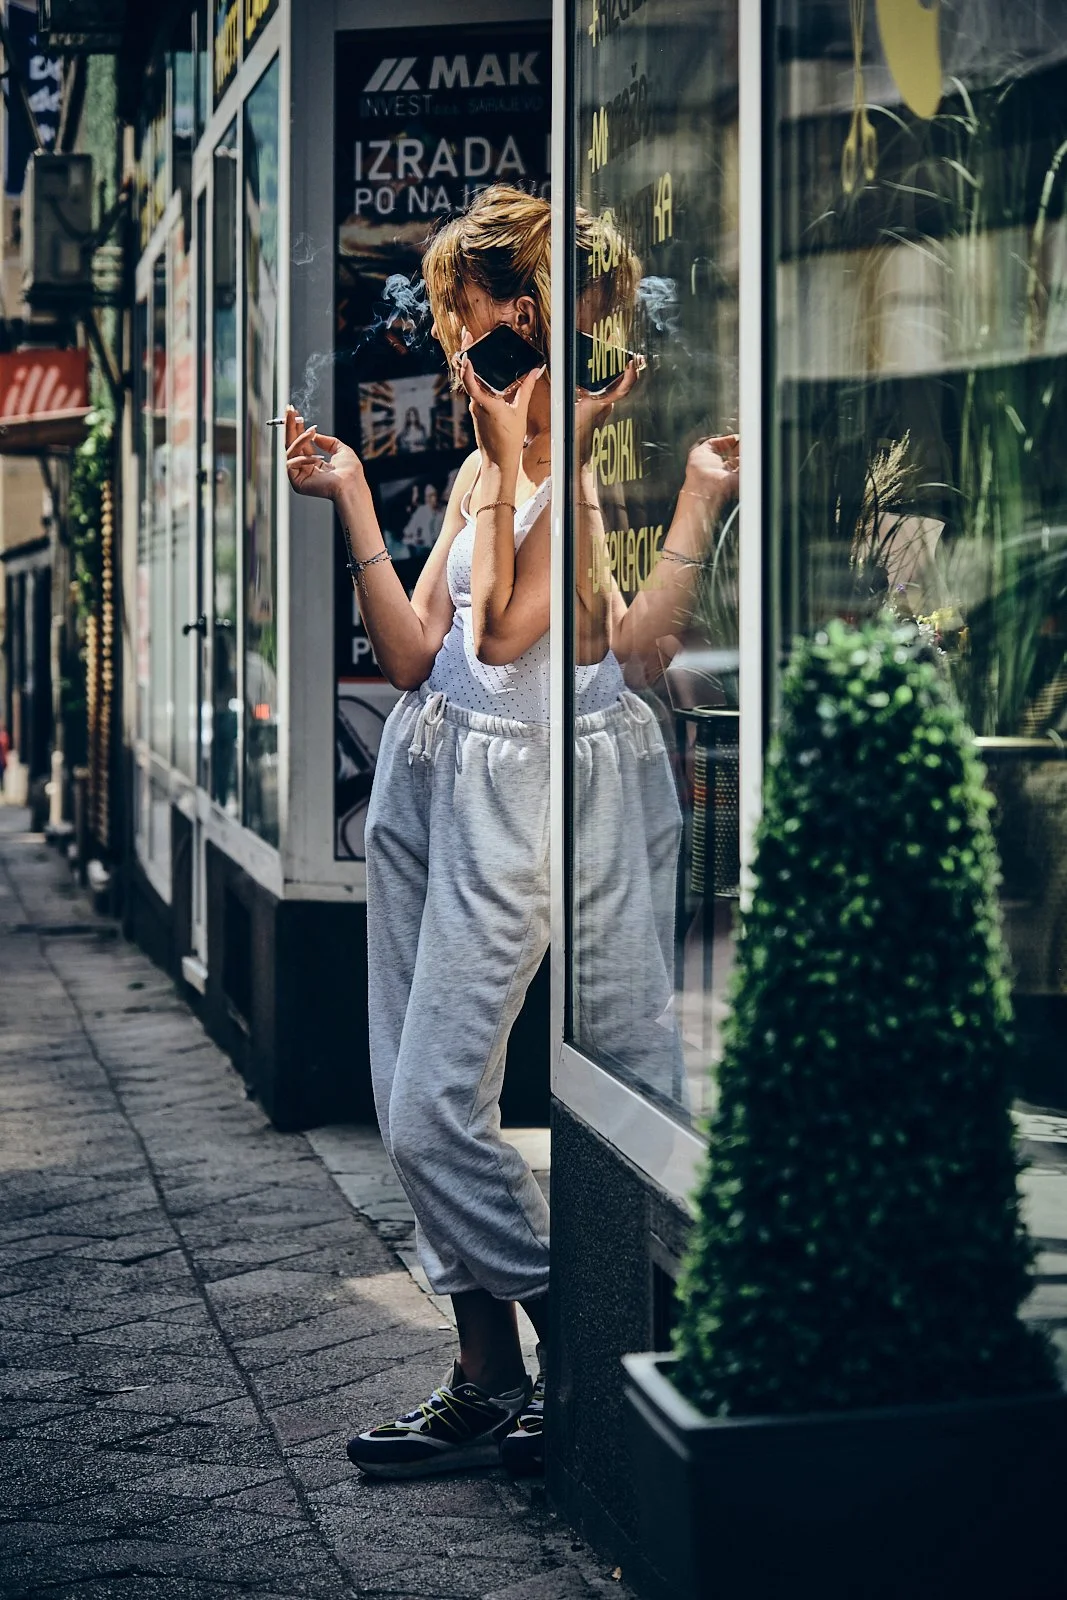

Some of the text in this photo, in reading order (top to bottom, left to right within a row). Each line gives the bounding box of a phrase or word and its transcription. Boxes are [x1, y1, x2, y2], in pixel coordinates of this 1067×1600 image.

[429, 52, 540, 90] MAK
[360, 94, 432, 117] INVEST
[354, 136, 526, 180] IZRADA
[354, 186, 395, 215] PO
